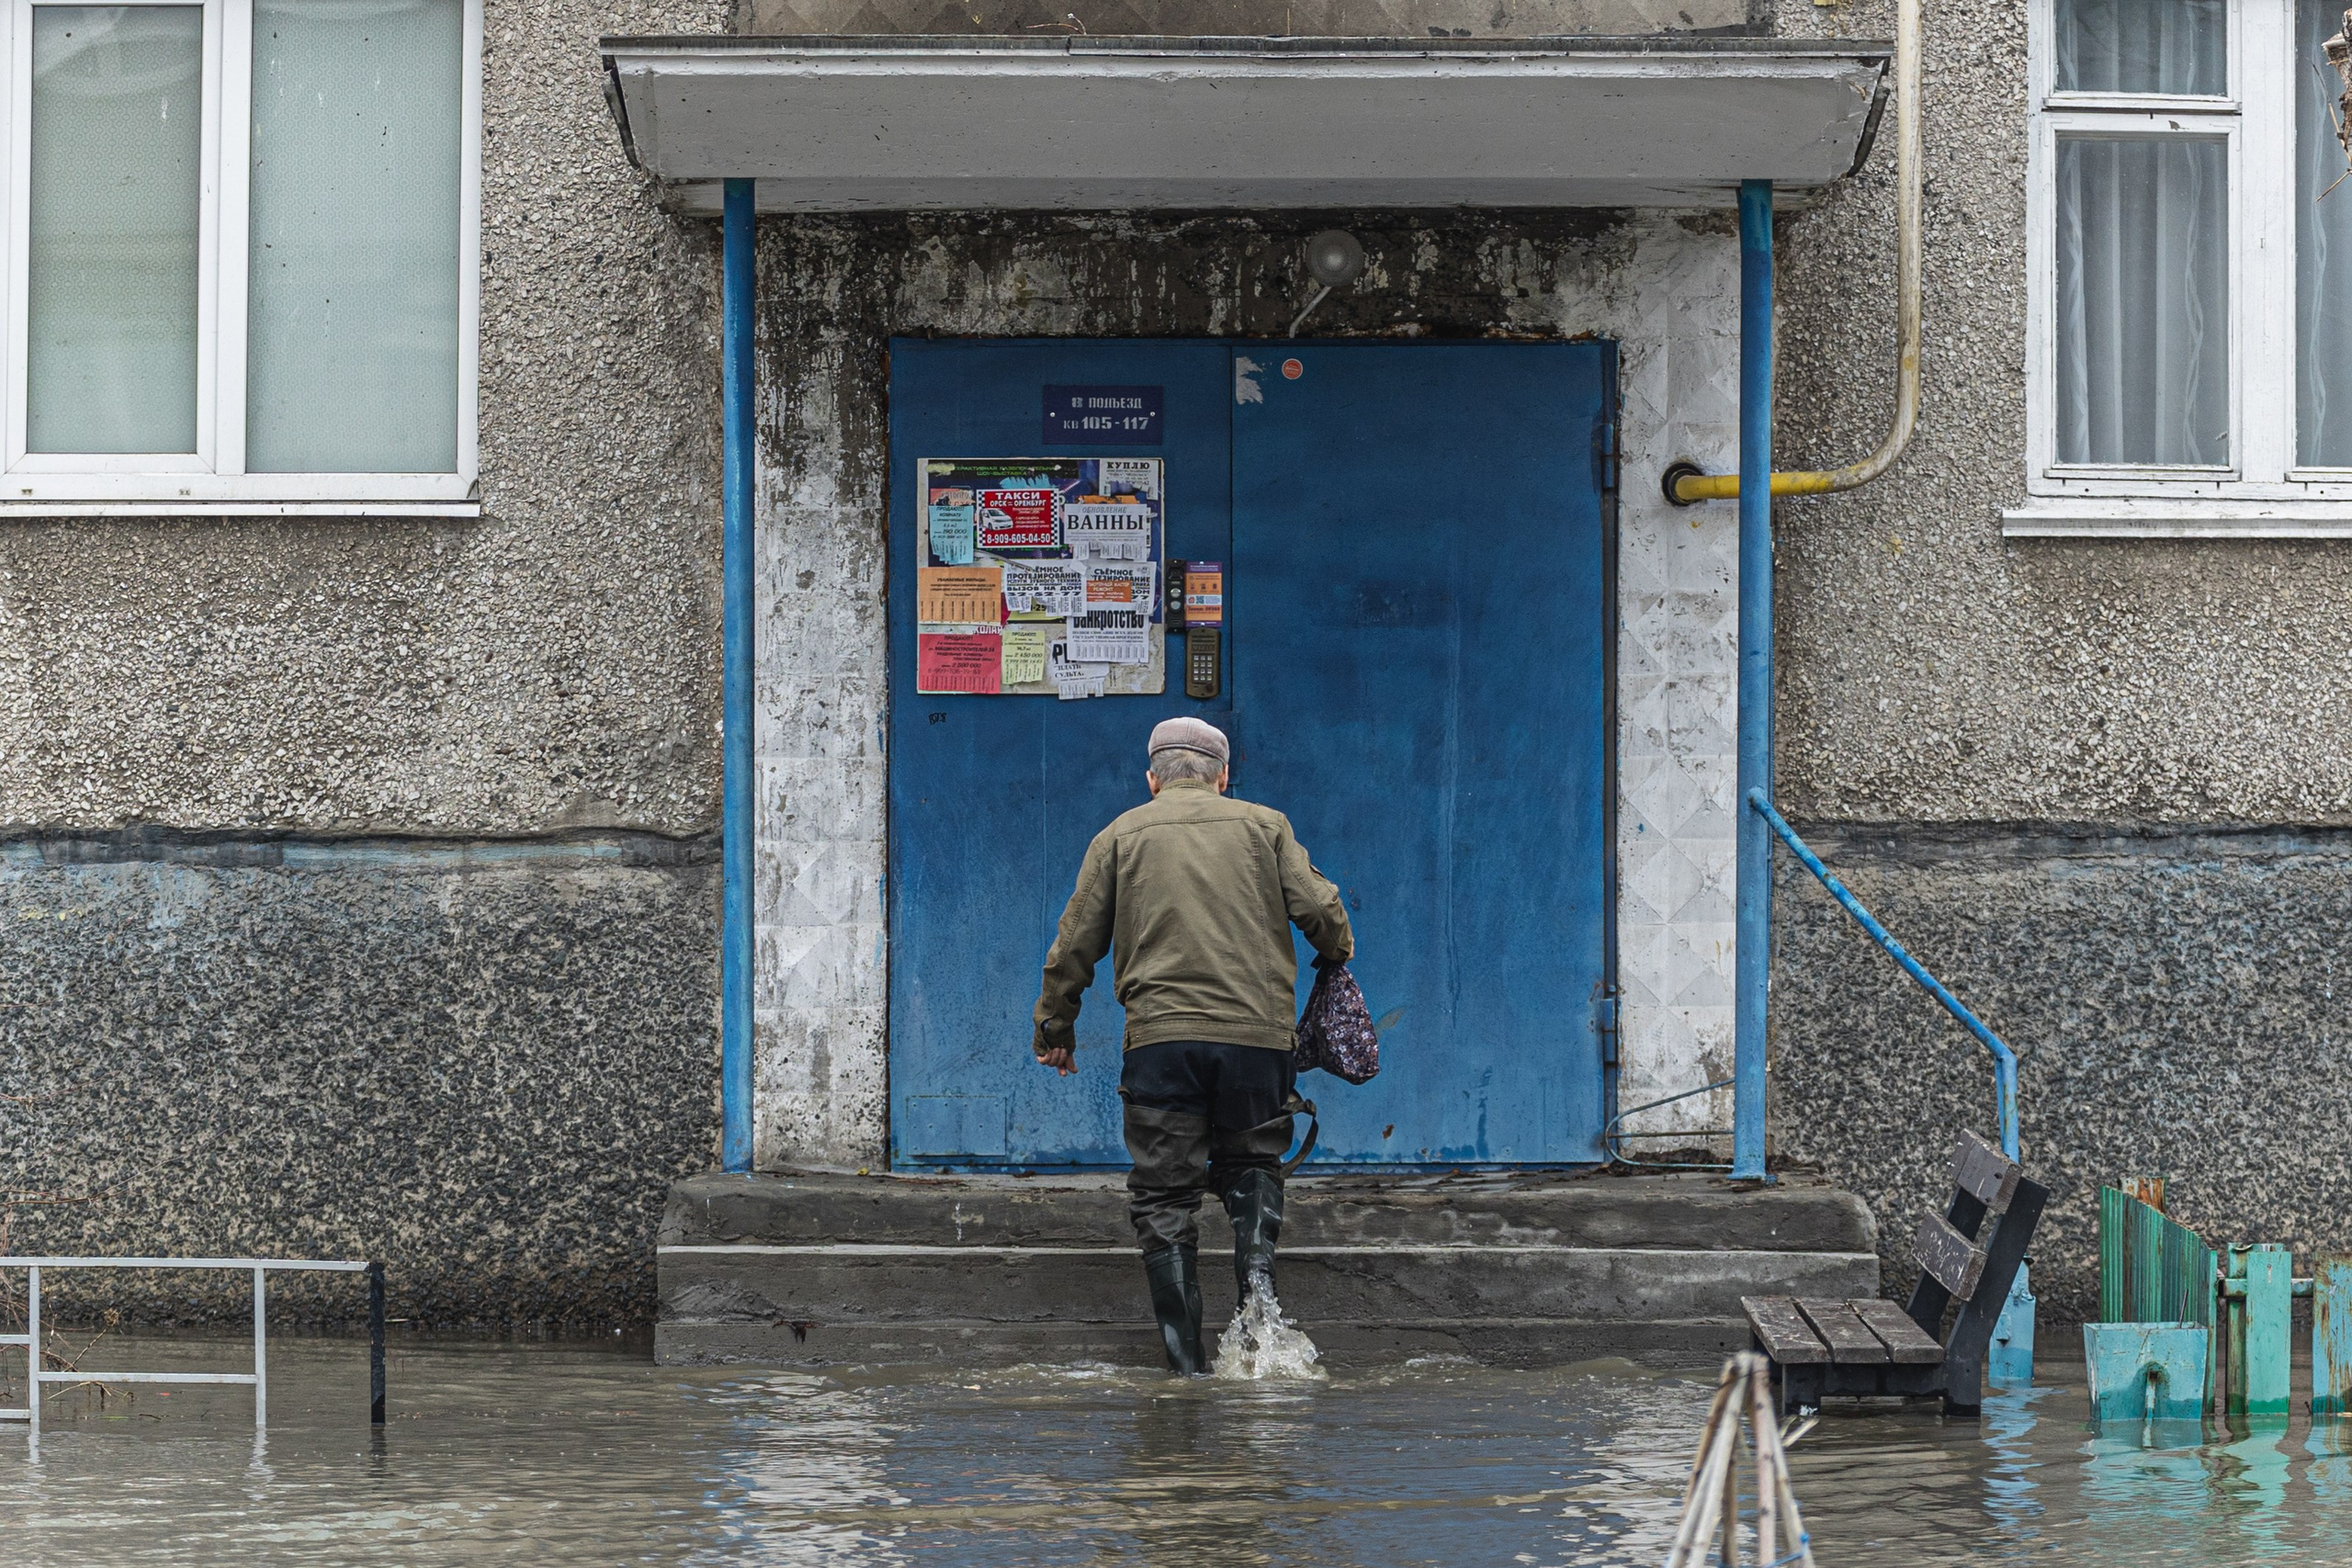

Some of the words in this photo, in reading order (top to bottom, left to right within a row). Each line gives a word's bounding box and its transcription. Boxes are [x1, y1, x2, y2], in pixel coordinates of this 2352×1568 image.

[1089, 397, 1142, 409] ПОДЪЕЗД
[1106, 461, 1150, 469] КУПЛЮ
[995, 491, 1041, 500] ТАКСИ
[1067, 514, 1144, 530] ВАННЫ
[987, 533, 1051, 544] 8-909-605-04-50
[1094, 568, 1134, 576] СЪЁМНОЕ
[1073, 610, 1145, 631] Банкротство
